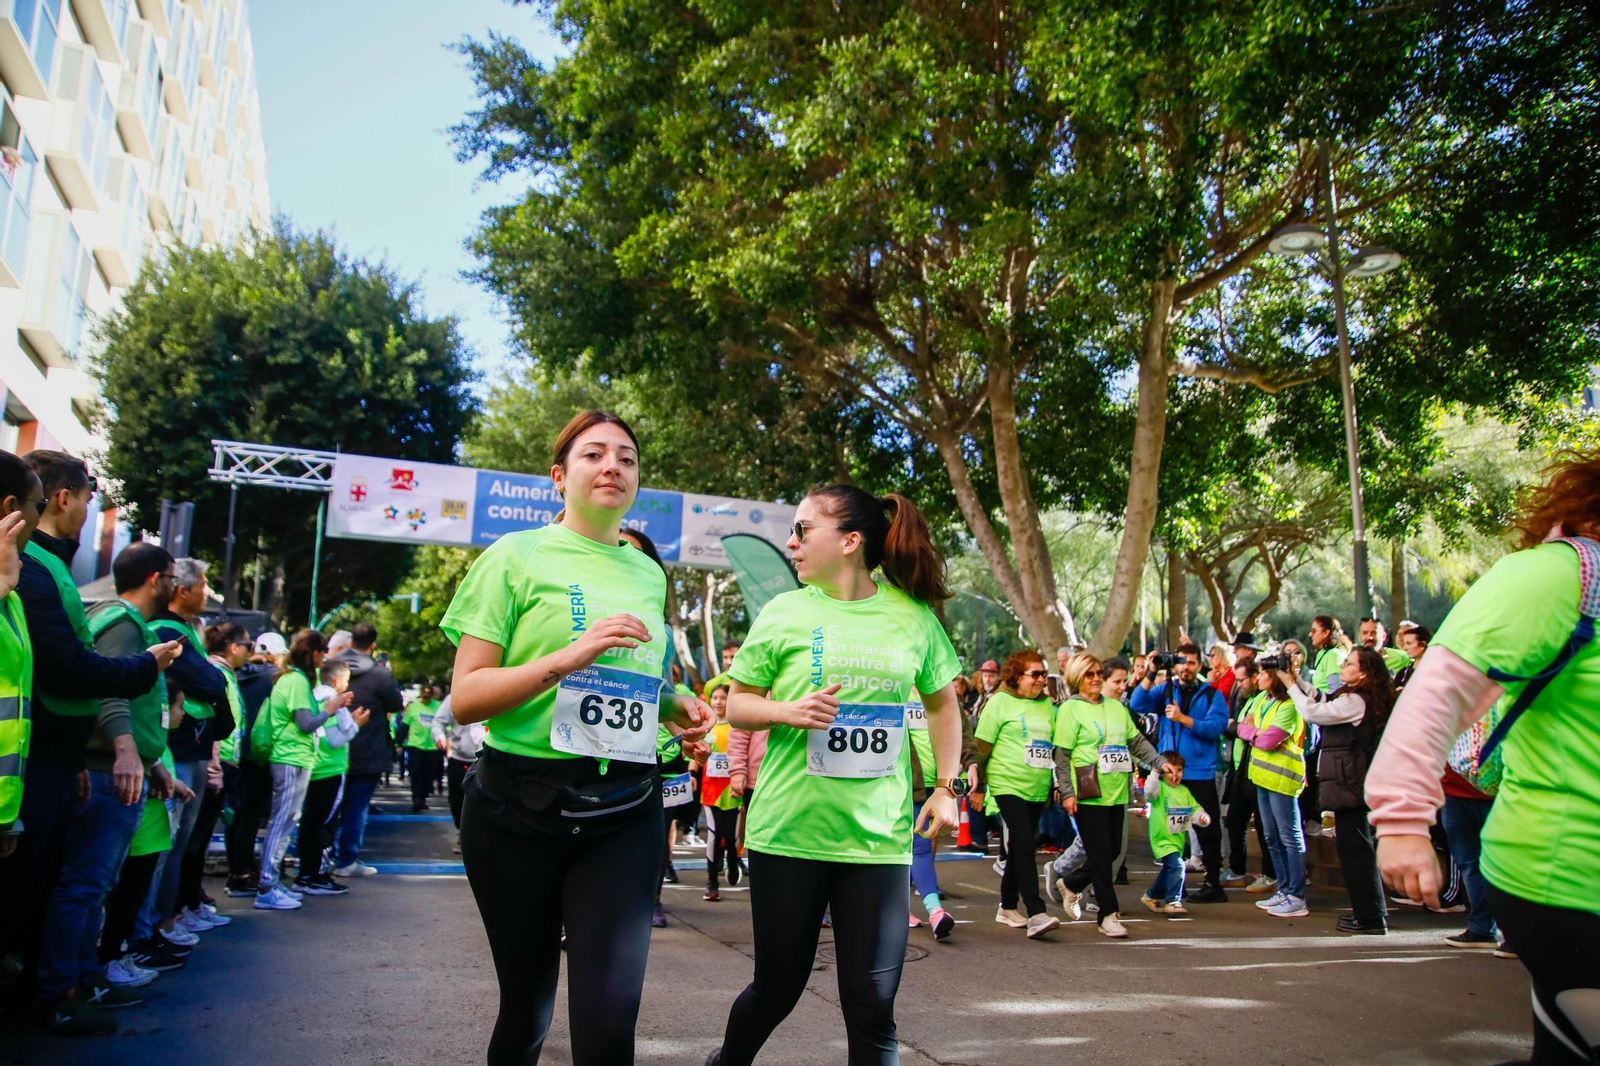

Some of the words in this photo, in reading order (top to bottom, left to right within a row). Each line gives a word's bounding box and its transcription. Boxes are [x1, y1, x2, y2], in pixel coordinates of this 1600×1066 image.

[487, 504, 553, 523] contra
[565, 583, 587, 642] MERÍA
[826, 640, 847, 652] En
[849, 643, 904, 658] marcha
[826, 655, 885, 671] contra
[889, 659, 903, 674] el
[565, 674, 592, 684] contra
[594, 678, 602, 686] el
[603, 680, 630, 690] cáncer
[826, 670, 903, 693] cáncer
[579, 694, 644, 732] 638
[844, 712, 867, 720] cáncer
[827, 727, 888, 754] 808
[1102, 753, 1129, 764] 1524
